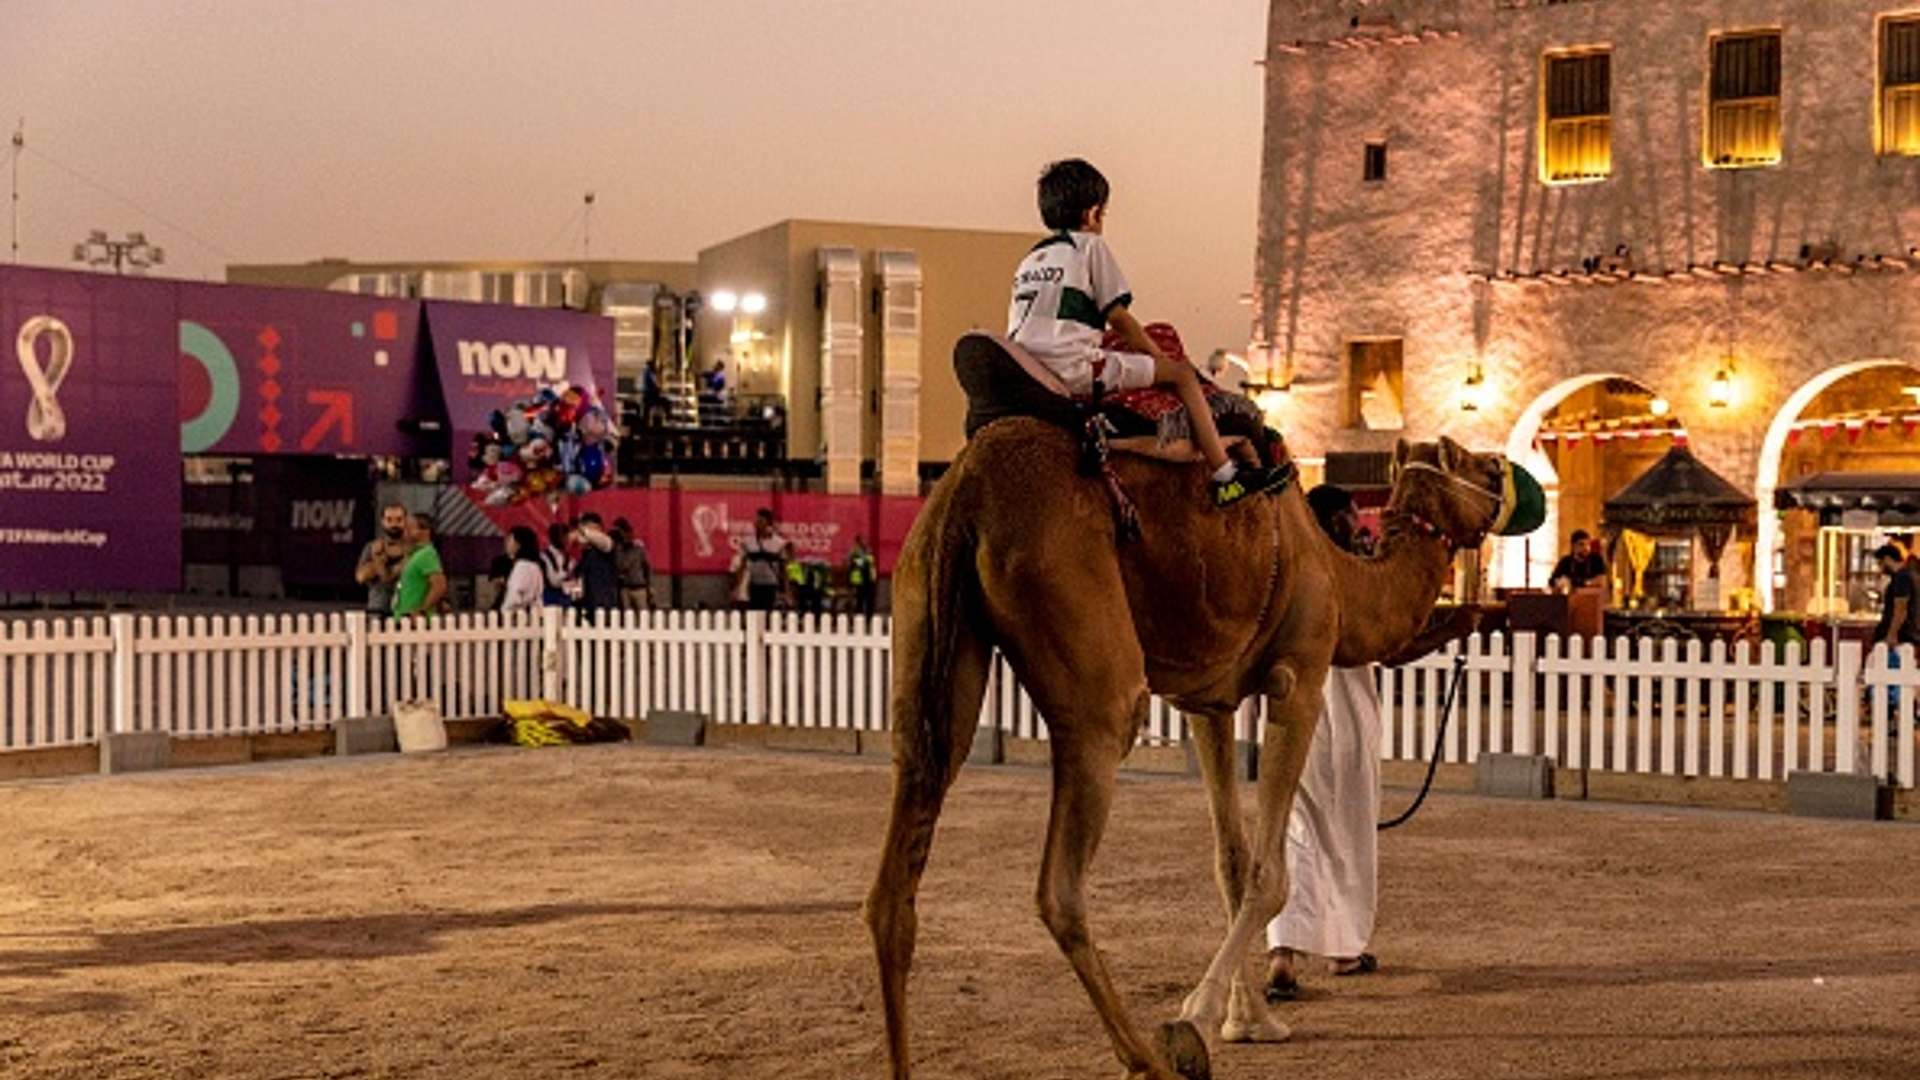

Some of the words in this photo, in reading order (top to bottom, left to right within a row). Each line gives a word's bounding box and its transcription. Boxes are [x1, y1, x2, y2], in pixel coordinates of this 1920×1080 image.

[1009, 290, 1038, 342] 7
[457, 340, 567, 379] now
[0, 453, 13, 469] A
[15, 453, 78, 470] WORLD
[81, 455, 116, 471] CUP
[0, 472, 106, 491] atar2022
[291, 500, 356, 529] now
